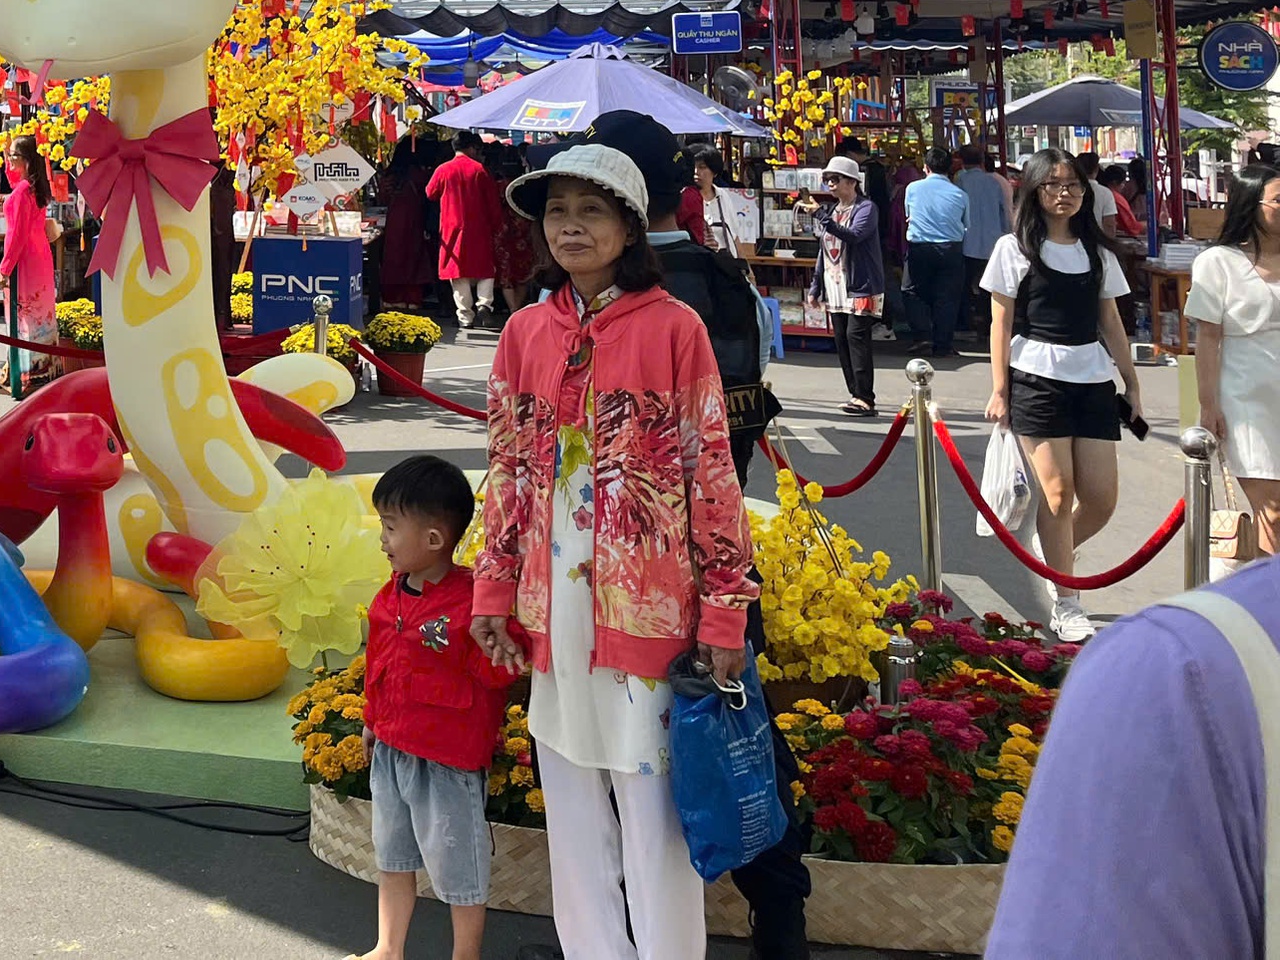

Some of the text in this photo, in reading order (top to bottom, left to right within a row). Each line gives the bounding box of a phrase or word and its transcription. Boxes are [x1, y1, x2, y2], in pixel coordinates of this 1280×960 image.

[699, 30, 715, 38] THU
[715, 29, 738, 37] NGÂN
[1218, 40, 1263, 53] NHÀ
[1219, 51, 1265, 69] SÁCH
[520, 118, 570, 126] CITY
[261, 274, 339, 294] PNC
